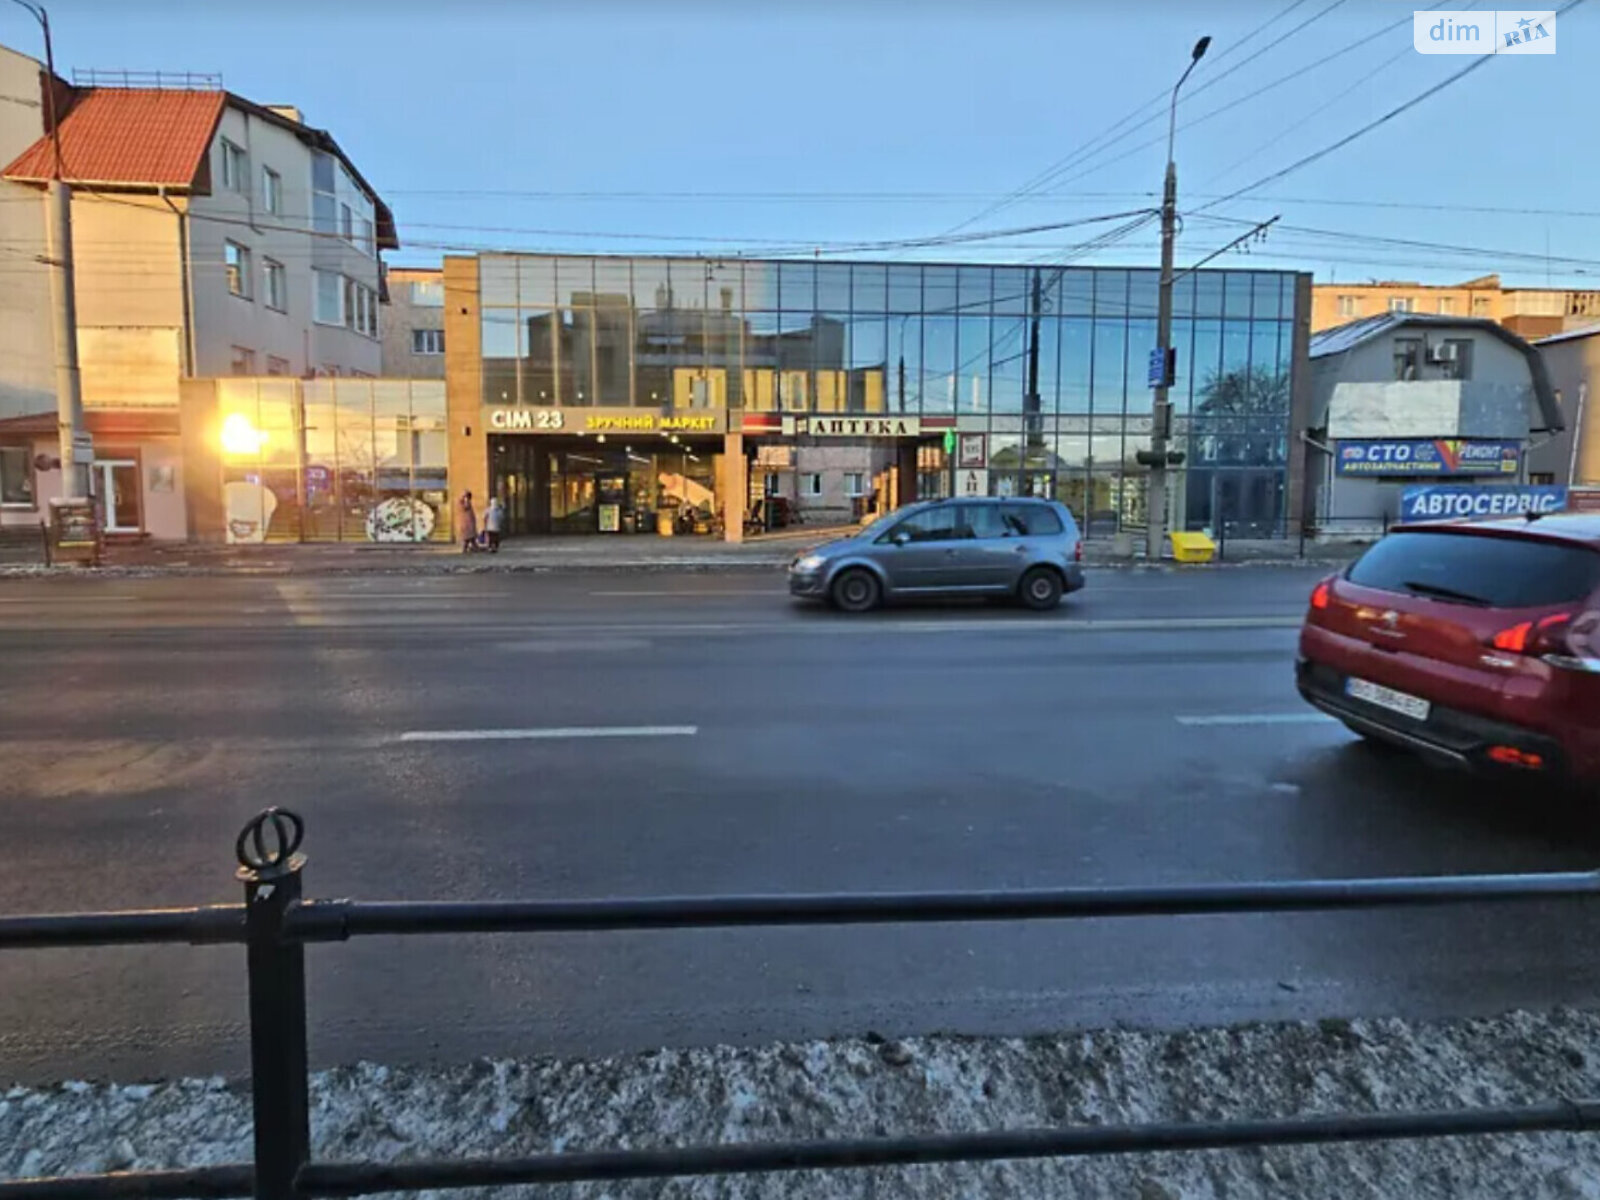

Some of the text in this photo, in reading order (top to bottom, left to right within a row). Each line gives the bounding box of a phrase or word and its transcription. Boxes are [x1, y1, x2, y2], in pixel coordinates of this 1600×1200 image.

[537, 411, 564, 428] 23
[586, 414, 716, 430] ЗРУЧНИЙ МАРКЕТ
[815, 419, 908, 434] АПТЕКА
[1367, 444, 1411, 461] СТО
[1411, 493, 1556, 515] АВТОСЕРВІС
